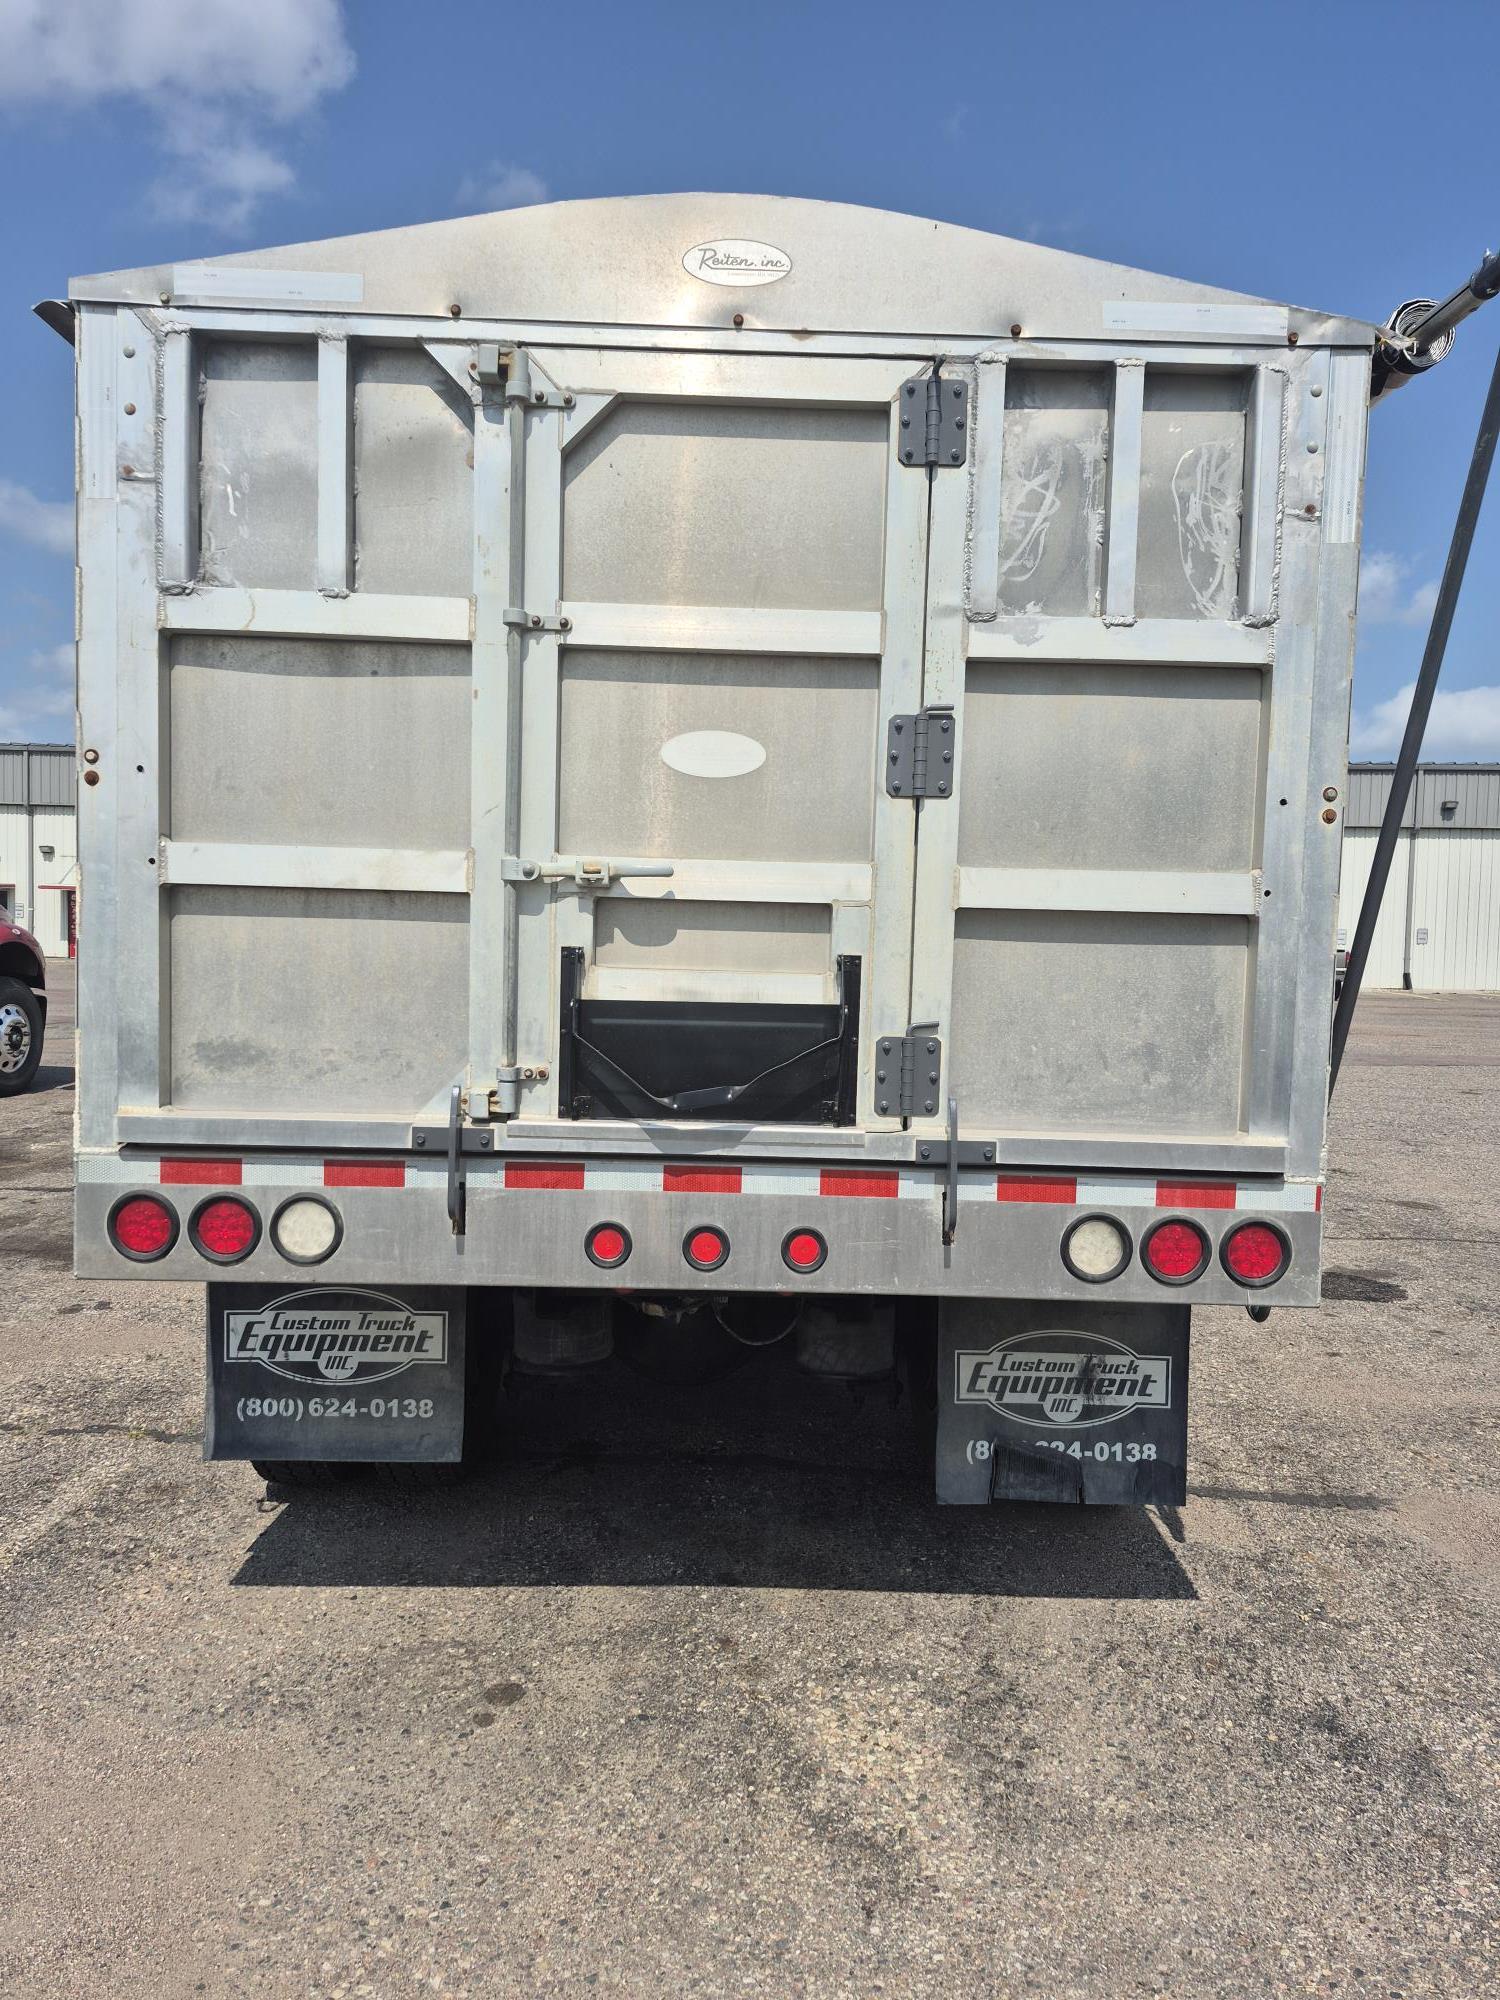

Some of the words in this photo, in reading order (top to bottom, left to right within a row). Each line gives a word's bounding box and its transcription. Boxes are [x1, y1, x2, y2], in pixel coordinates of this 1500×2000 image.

[270, 1311, 351, 1331] Custom
[357, 1312, 416, 1332] Truck
[236, 1320, 434, 1360] Equipment
[998, 1353, 1076, 1373] Custom
[1083, 1354, 1140, 1375] Truck
[966, 1361, 1157, 1402] Equipment
